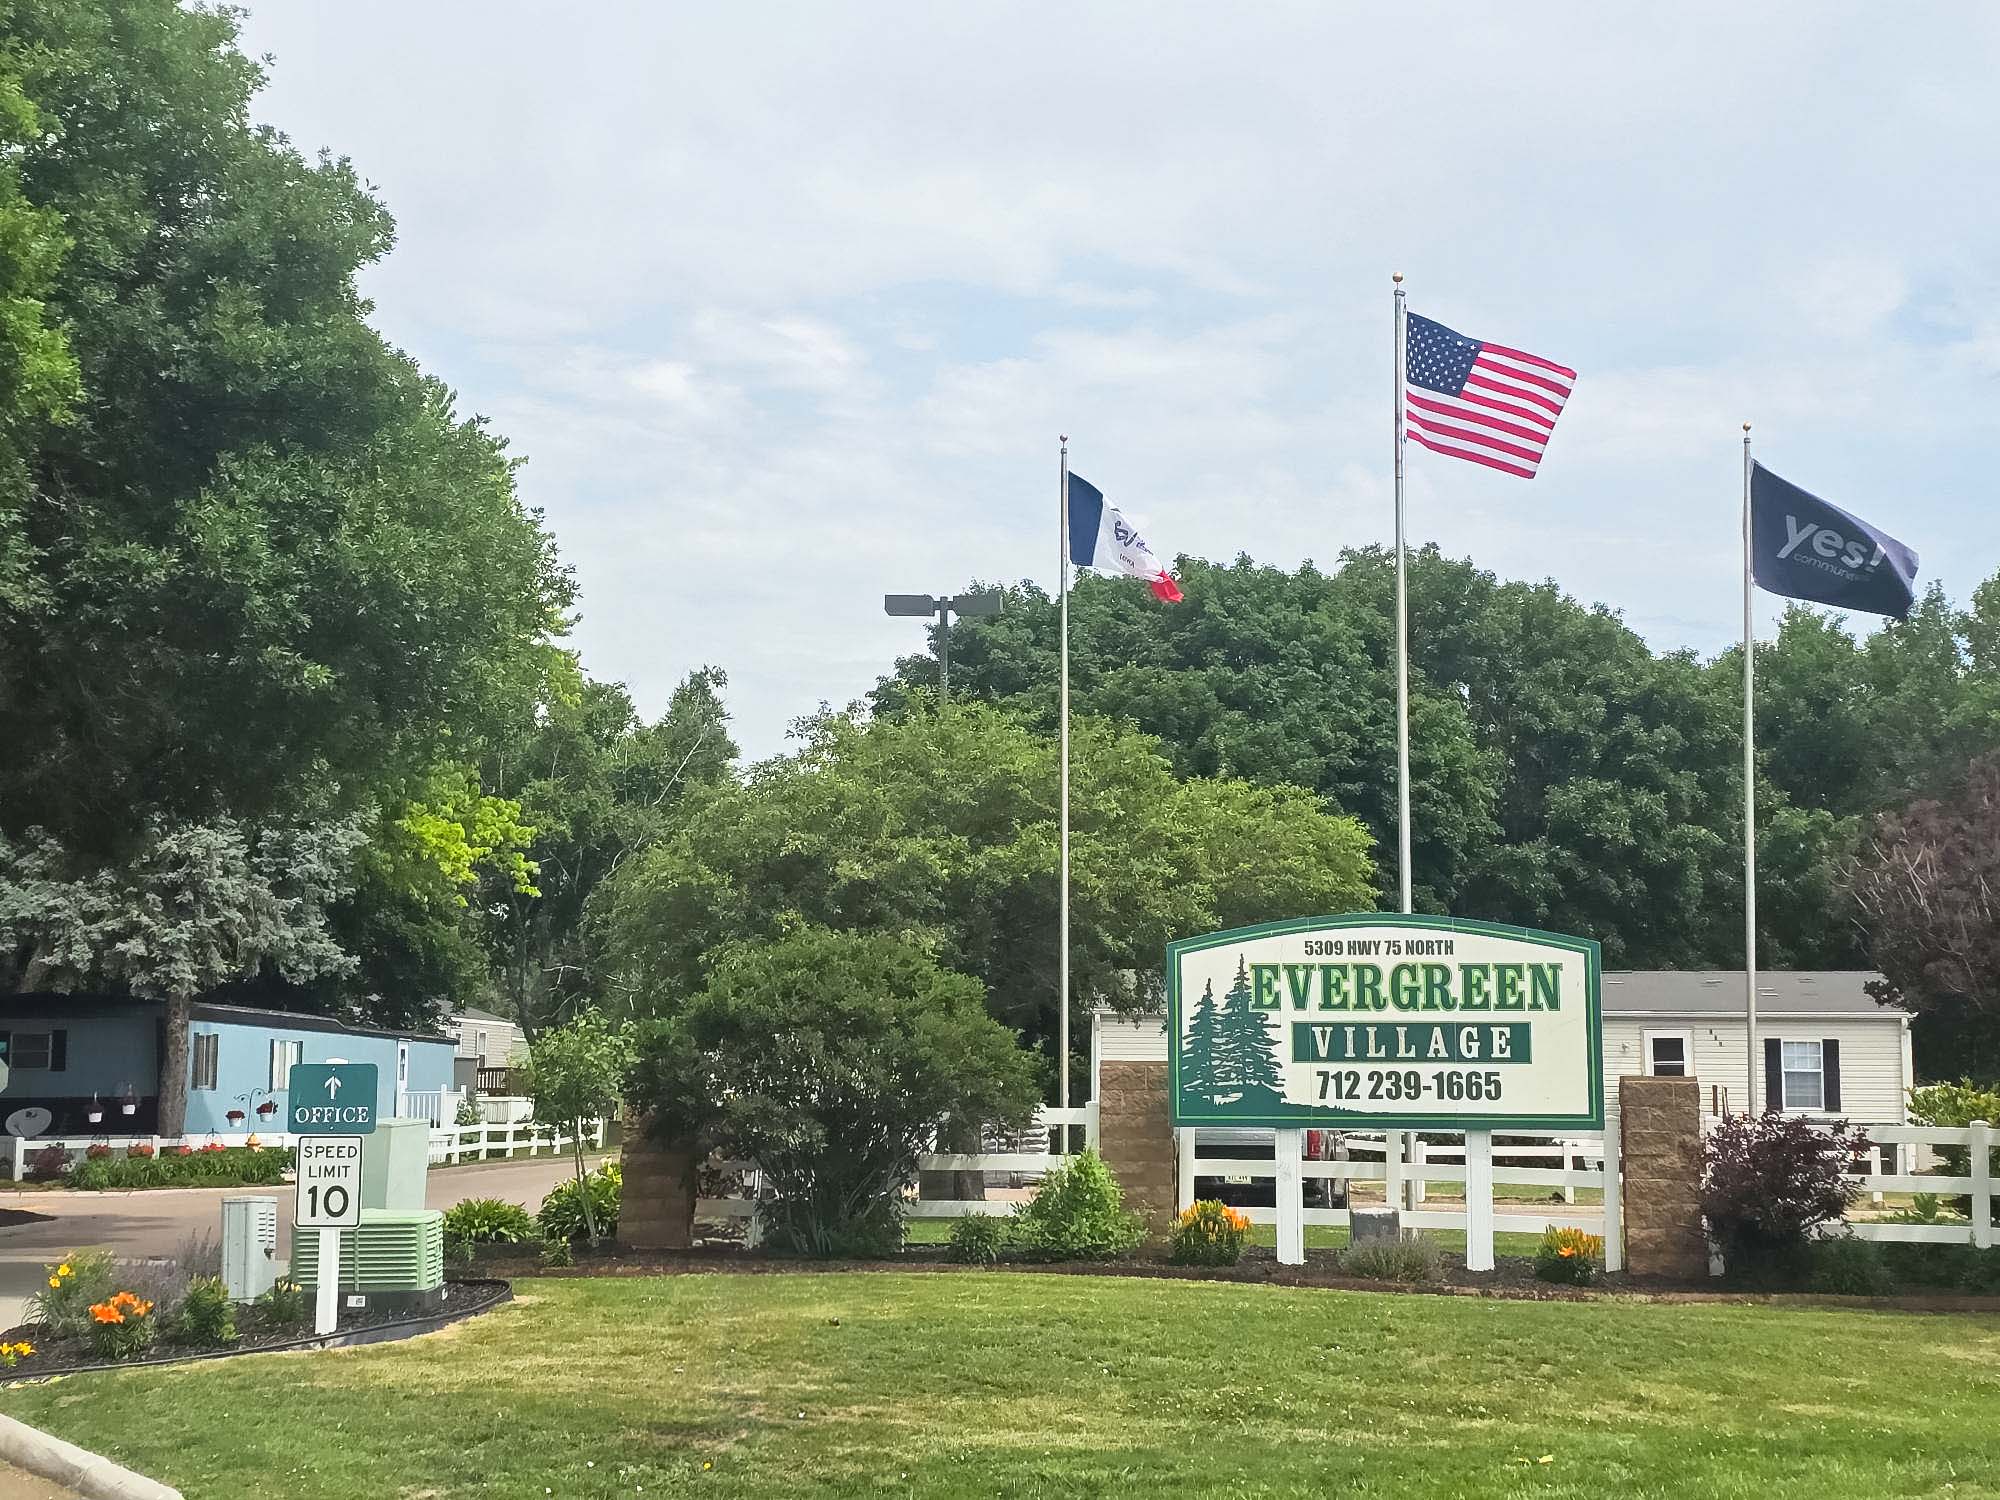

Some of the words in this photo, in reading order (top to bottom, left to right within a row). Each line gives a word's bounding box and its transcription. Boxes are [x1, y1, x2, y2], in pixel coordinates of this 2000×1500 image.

[1305, 940, 1343, 956] 5309
[1347, 940, 1381, 956] HWY
[1385, 940, 1401, 956] 75
[1406, 939, 1454, 955] NORTH
[1249, 962, 1563, 1012] EVERGREEN
[1312, 1026, 1512, 1059] VILLAGE
[1317, 1070, 1360, 1101] 712
[1368, 1070, 1502, 1101] 239-1665
[295, 1106, 369, 1124] OFFICE
[303, 1145, 358, 1159] SPEED
[308, 1165, 351, 1178] LIMIT
[307, 1185, 349, 1218] 10
